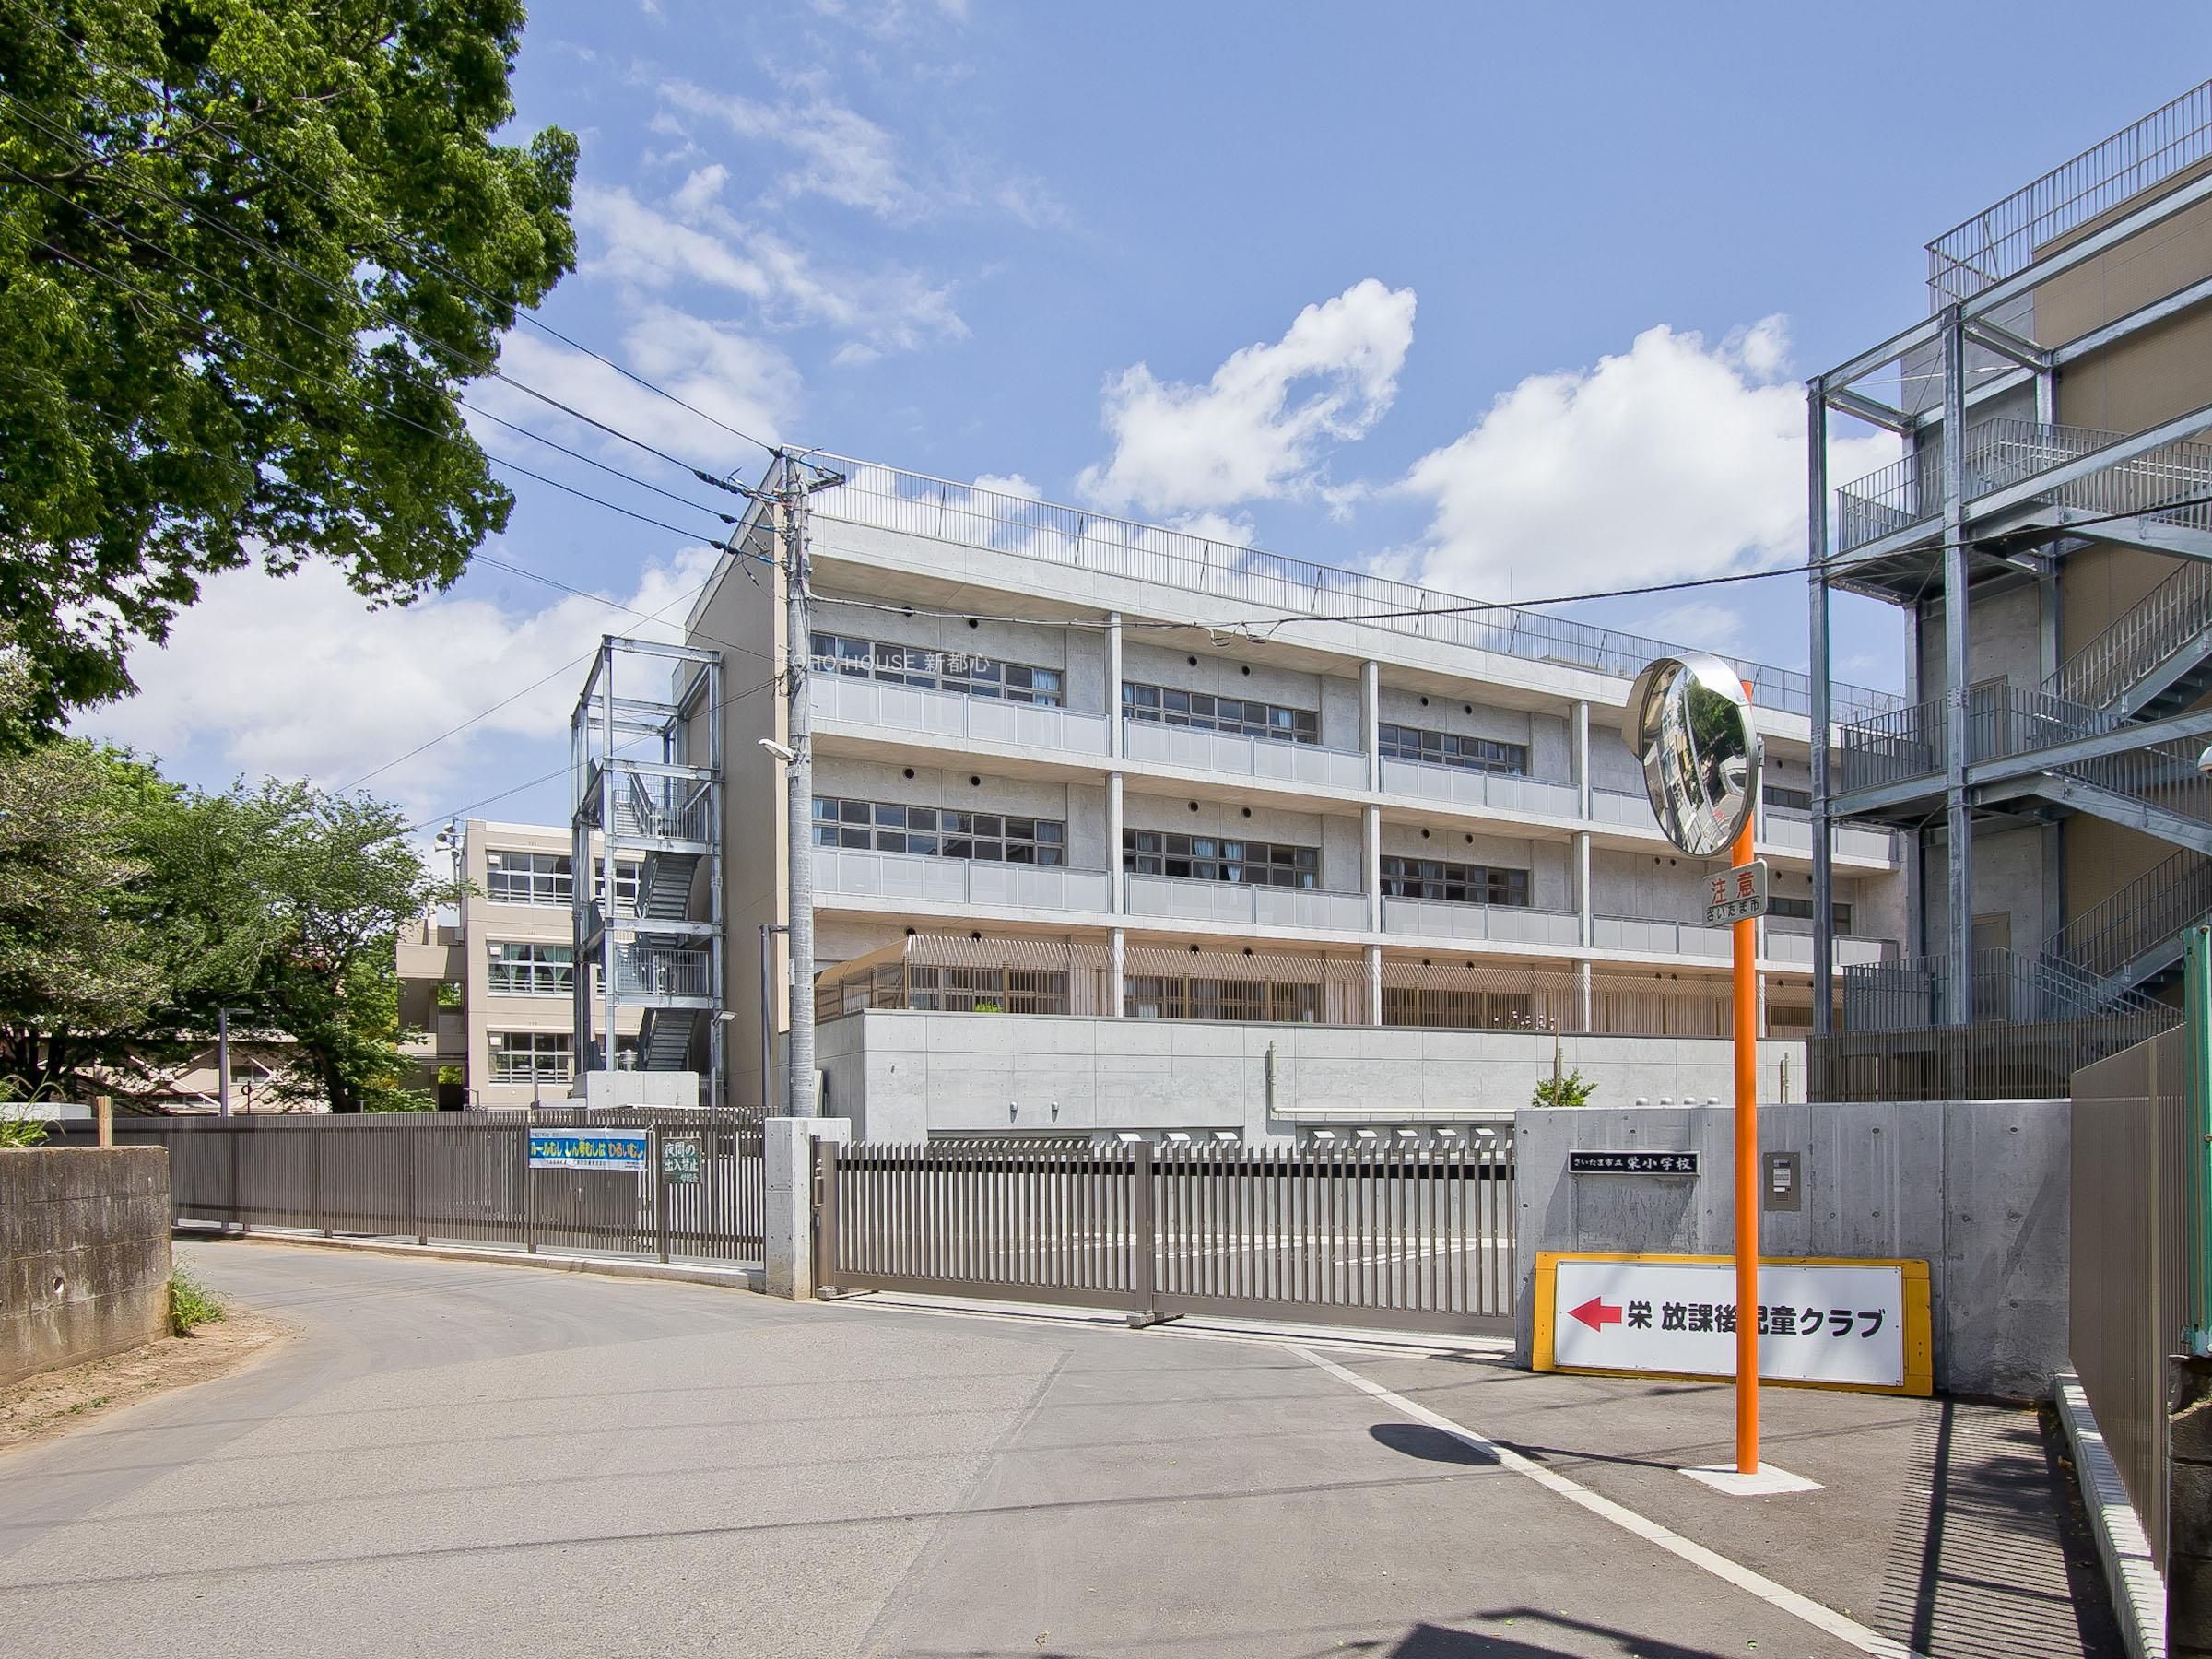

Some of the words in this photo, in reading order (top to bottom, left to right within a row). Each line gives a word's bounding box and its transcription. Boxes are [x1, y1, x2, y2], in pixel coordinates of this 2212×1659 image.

[1711, 871, 1755, 903] 注意
[1706, 897, 1759, 921] さいたま市
[664, 1141, 696, 1158] 夜間の
[1573, 1158, 1623, 1167] さいたま市立
[1627, 1156, 1693, 1171] 栄小学校
[1628, 1300, 1653, 1329] 栄
